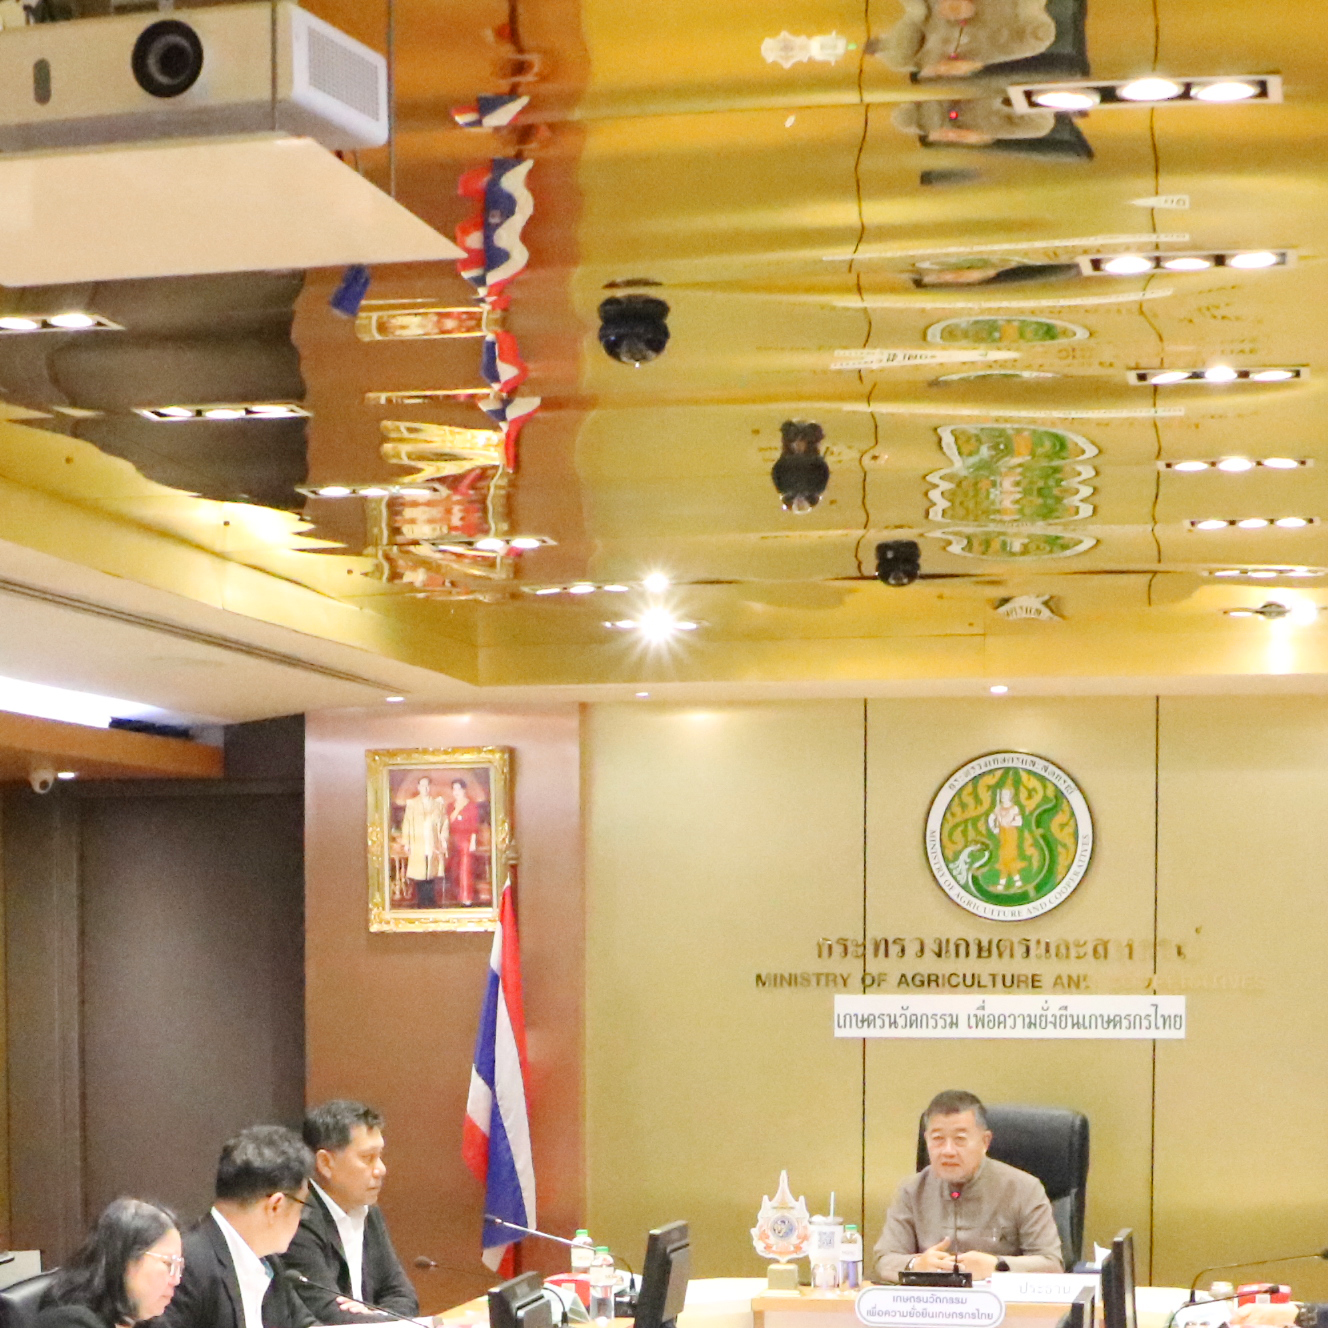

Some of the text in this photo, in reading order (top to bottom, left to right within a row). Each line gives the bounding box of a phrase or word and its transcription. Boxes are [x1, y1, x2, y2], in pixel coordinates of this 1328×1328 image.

[754, 972, 852, 989] MINISTRY
[860, 972, 889, 989] OF
[896, 972, 1043, 990] AGRICULTURE
[836, 1004, 959, 1031] เกษตรนวัตกรรม
